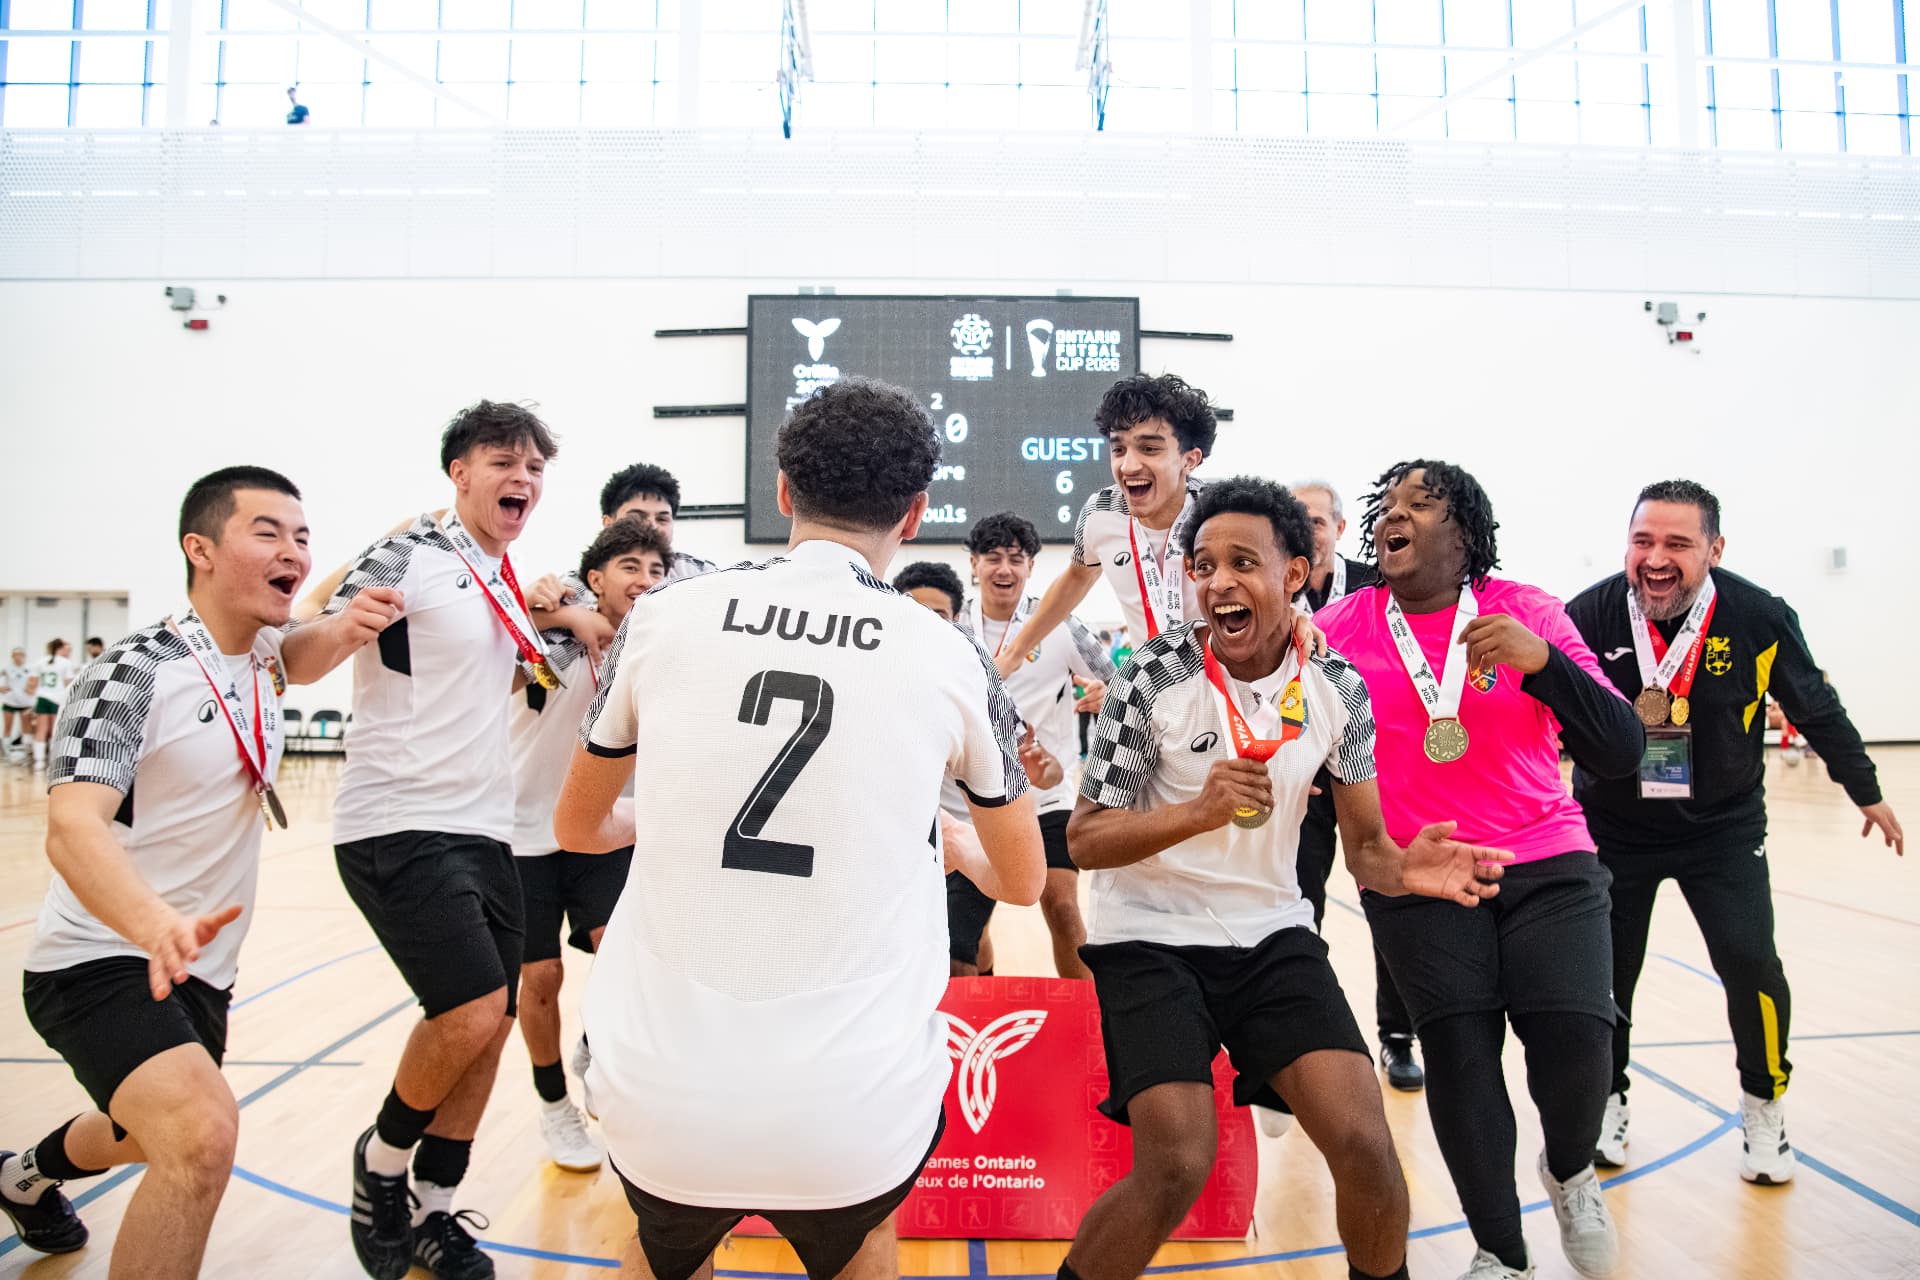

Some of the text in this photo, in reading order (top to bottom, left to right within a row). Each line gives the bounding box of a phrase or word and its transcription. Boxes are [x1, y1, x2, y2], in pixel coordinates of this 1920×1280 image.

[1056, 330, 1120, 344] ONTARIO
[1056, 343, 1120, 357] FUTSAL
[1056, 357, 1084, 371] CUP
[930, 392, 943, 410] 2
[946, 413, 968, 443] 0
[1021, 437, 1105, 461] GUEST
[1056, 470, 1074, 494] 6
[1057, 504, 1072, 523] 6
[722, 598, 883, 651] LJUJIC
[196, 628, 213, 651] Orillia
[1421, 687, 1434, 705] 2026
[721, 670, 834, 878] 2
[924, 1155, 1037, 1169] ames Ontario
[915, 1174, 1045, 1189] eux de l'Ontario
